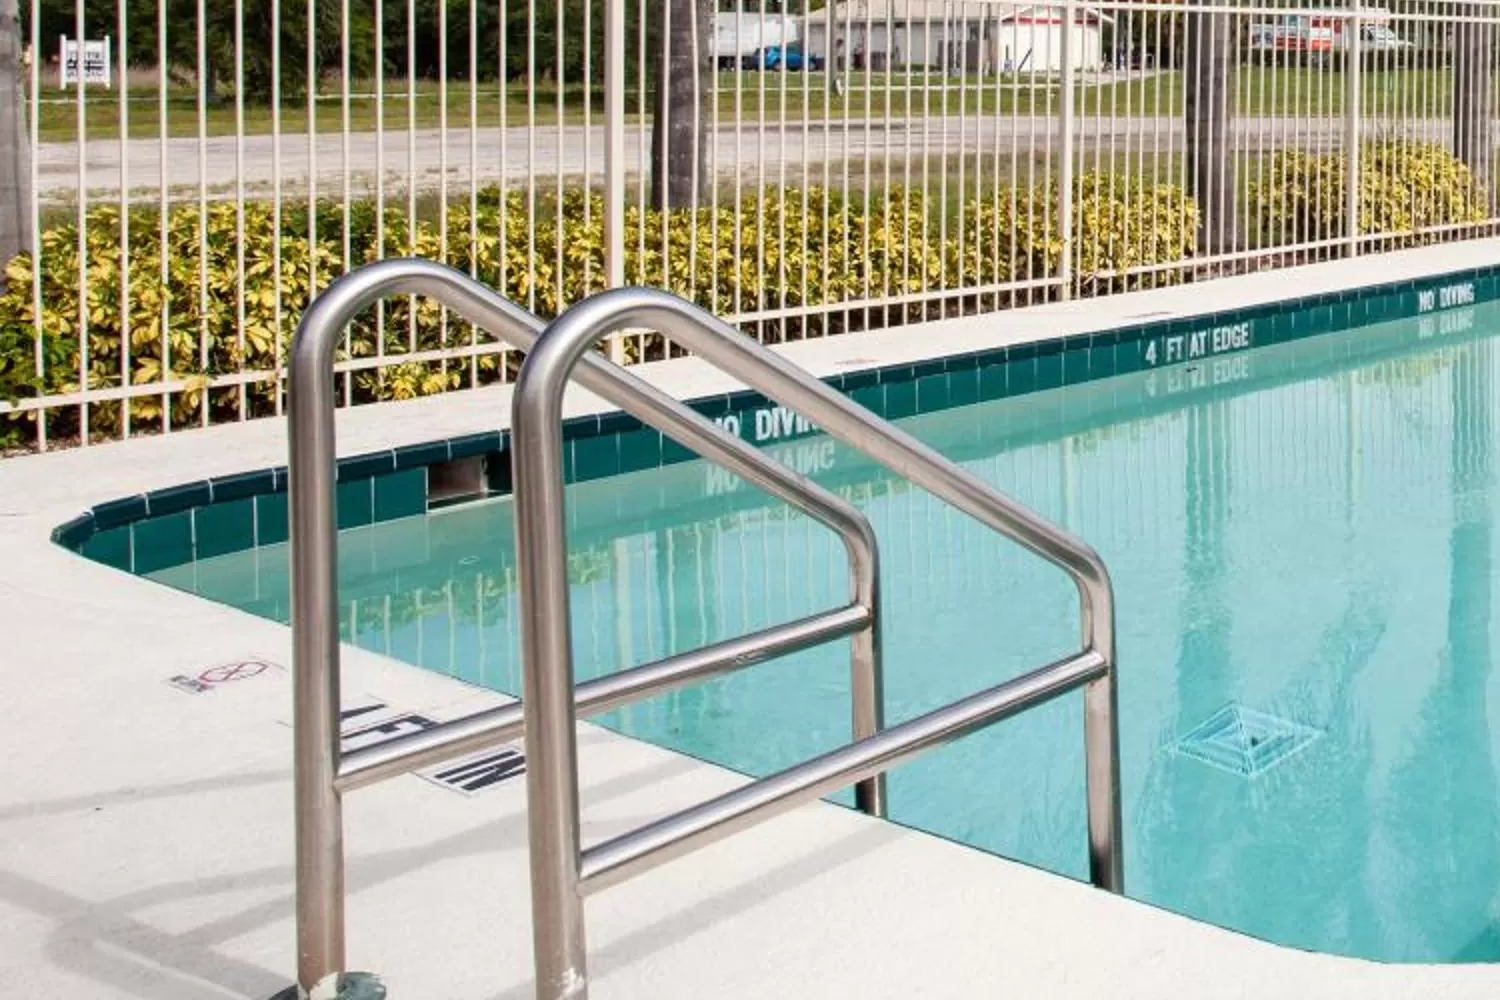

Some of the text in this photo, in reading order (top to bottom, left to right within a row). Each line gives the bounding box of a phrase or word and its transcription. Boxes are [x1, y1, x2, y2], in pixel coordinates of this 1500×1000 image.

[1419, 283, 1475, 313] NO DIVING
[1145, 322, 1249, 365] 4 FT AT EDGE
[755, 406, 818, 441] DIVI
